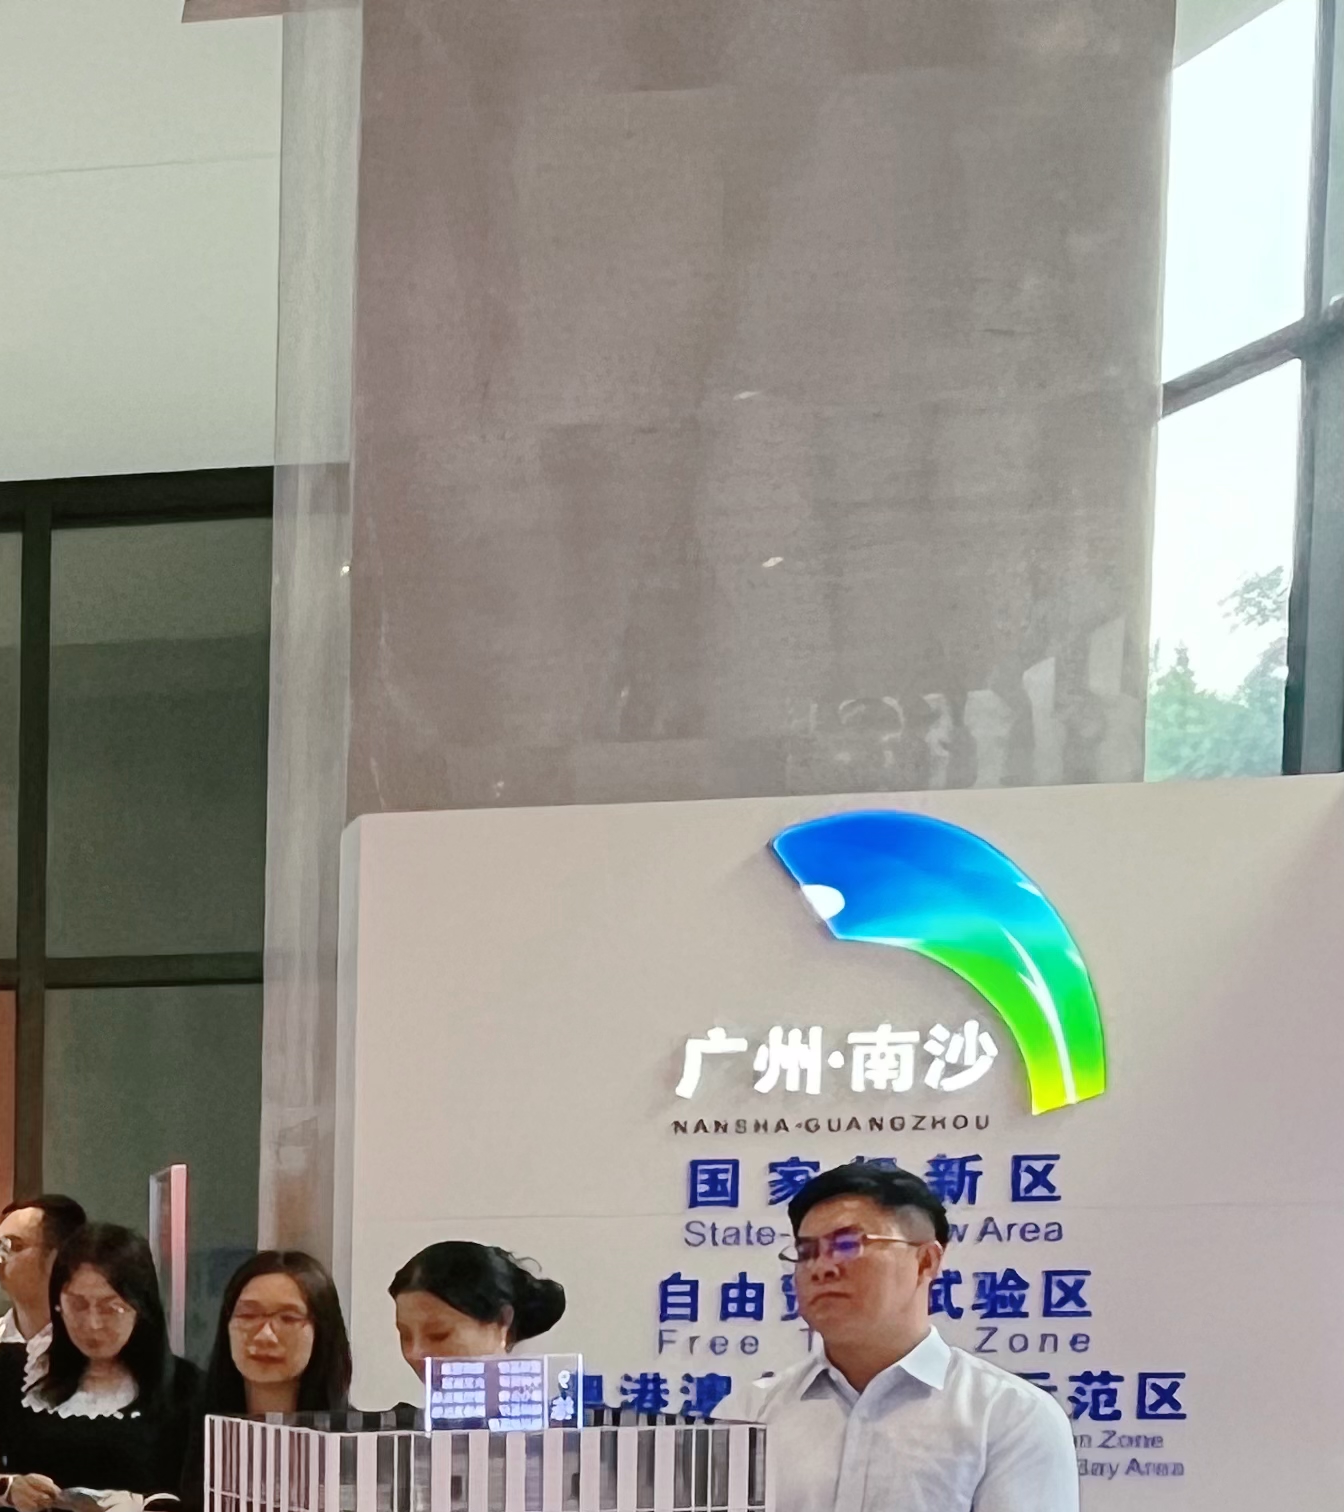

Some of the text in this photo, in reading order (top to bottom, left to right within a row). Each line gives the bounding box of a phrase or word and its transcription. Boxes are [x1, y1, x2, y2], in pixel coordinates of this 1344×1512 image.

[674, 1019, 999, 1099] 广州·南沙
[687, 1153, 1062, 1209] 国家新区
[976, 1216, 1064, 1243] Area
[659, 1267, 1093, 1323] 自由试验区
[658, 1326, 1090, 1356] Free Zone
[1097, 1430, 1165, 1449] Zone
[1125, 1458, 1186, 1477] Area
